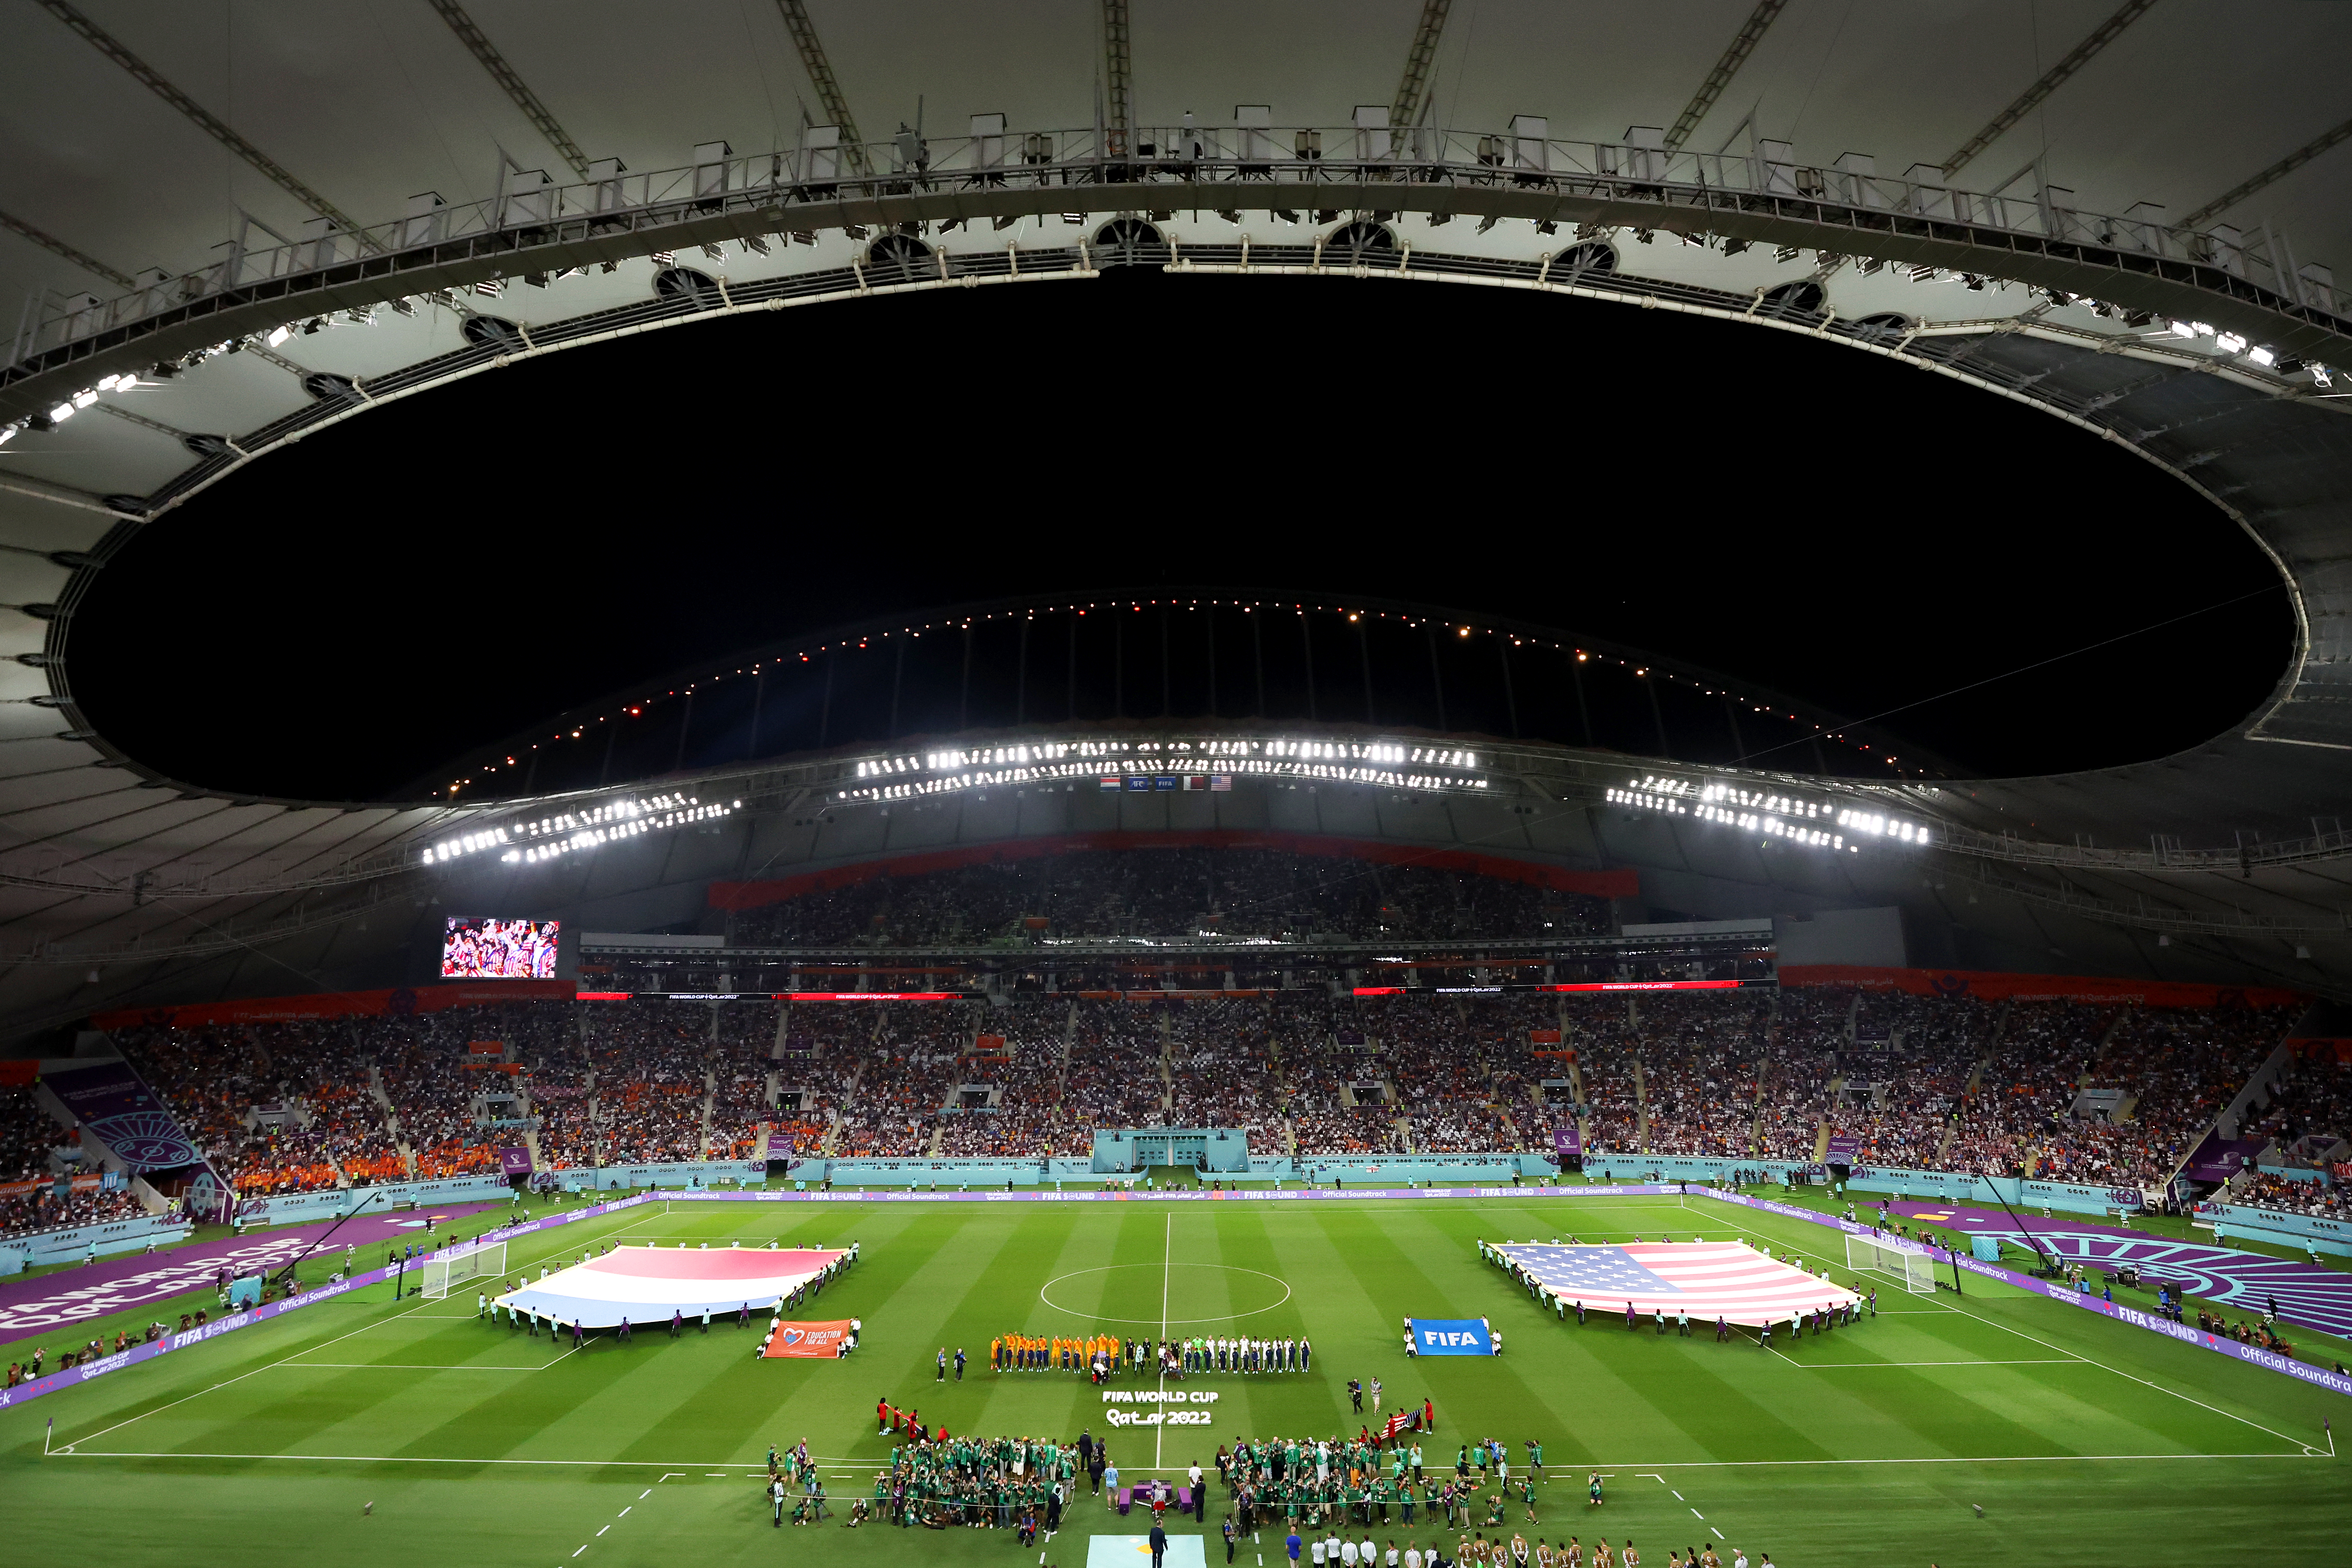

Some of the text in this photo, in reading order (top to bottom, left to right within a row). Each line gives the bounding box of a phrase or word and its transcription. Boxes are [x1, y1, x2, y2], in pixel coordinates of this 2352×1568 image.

[1709, 1190, 1723, 1199] FIFA
[606, 1201, 620, 1212] FIFA
[1764, 1202, 1813, 1220] Official Soundtrack
[493, 1222, 541, 1241] Official Soundtrack
[1881, 1232, 1896, 1245] FIFA
[434, 1249, 450, 1261] FIFA
[43, 1238, 304, 1300] WORLD CUP
[1945, 1253, 2008, 1281] Oficial Soundtrack
[279, 1281, 350, 1312] Official Soundtrack
[2056, 1286, 2071, 1296] WORLD
[2118, 1306, 2147, 1327] FIFA
[174, 1329, 203, 1348] FIFA
[807, 1330, 842, 1339] EDUCATION
[1424, 1331, 1478, 1346] FIFA
[81, 1351, 130, 1372] FIFA WORLD CUP
[2241, 1346, 2352, 1392] Official Soundtra
[1102, 1391, 1219, 1403] FIFA WORLD CUP
